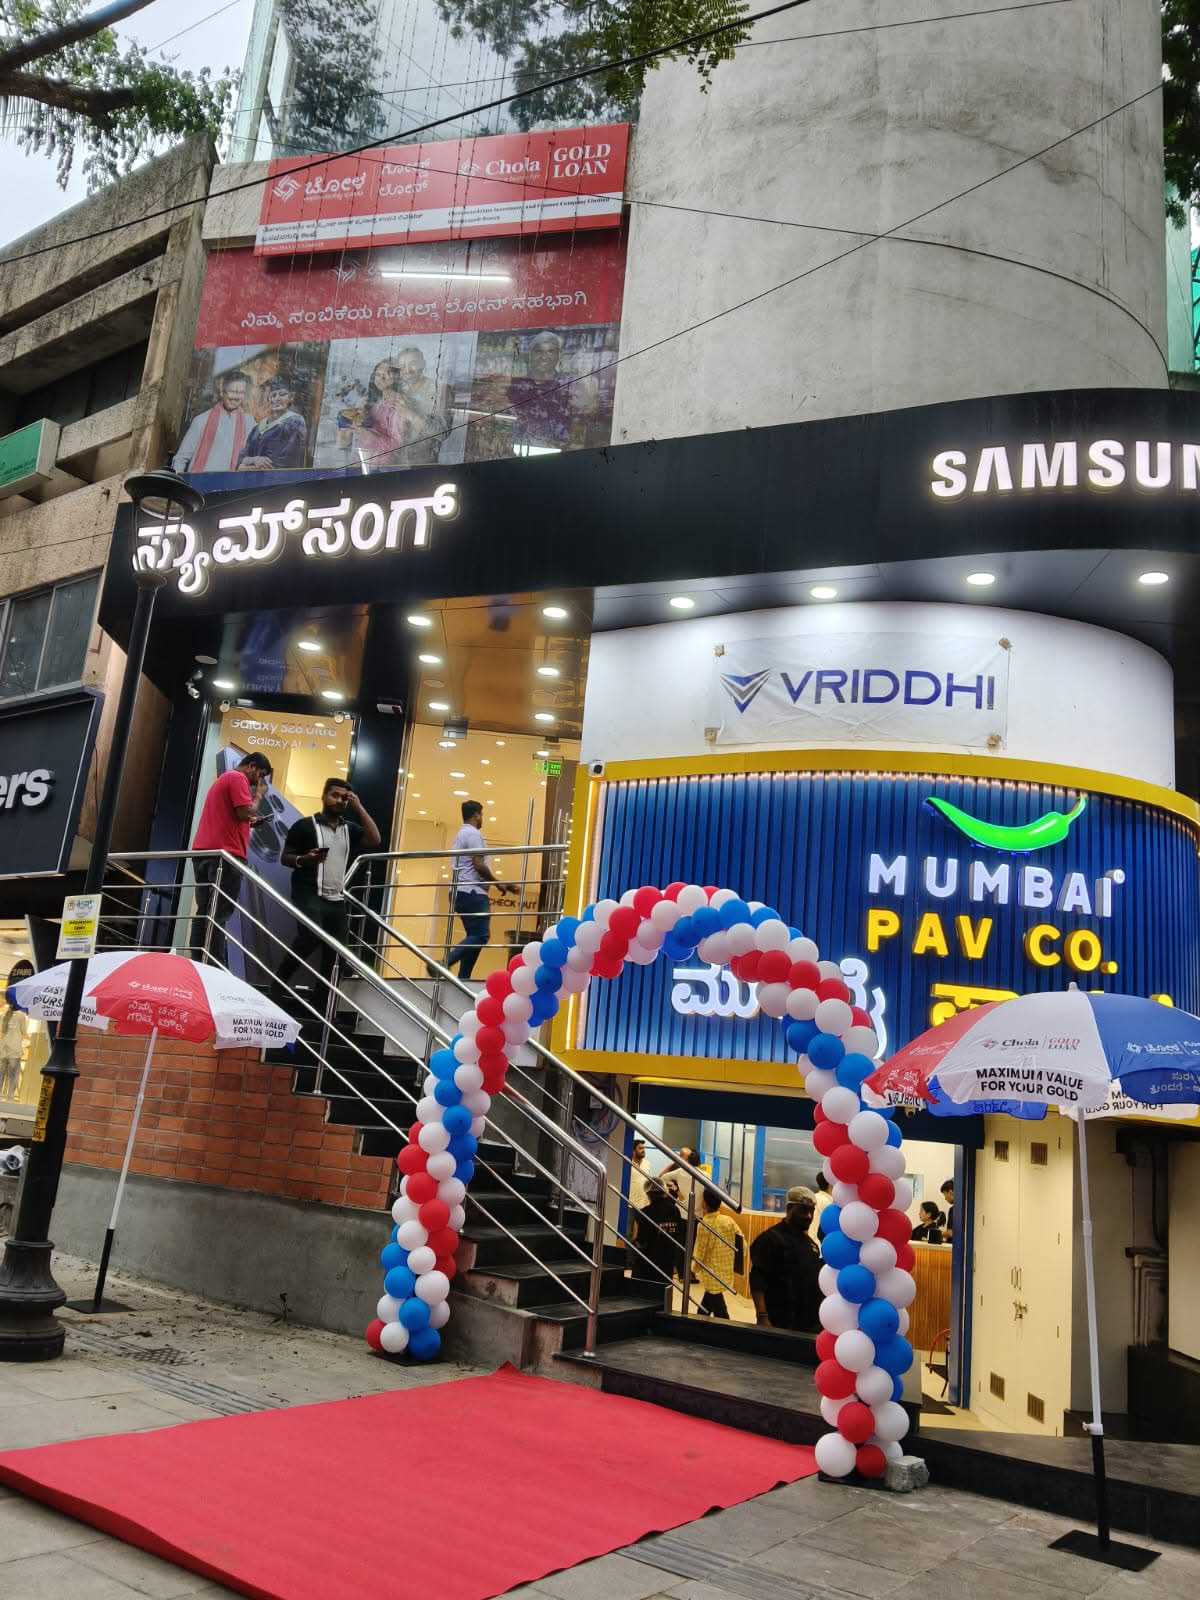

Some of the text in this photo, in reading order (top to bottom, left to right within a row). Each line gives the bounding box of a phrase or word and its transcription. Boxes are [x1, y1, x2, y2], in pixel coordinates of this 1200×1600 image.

[553, 143, 611, 162] GOLD
[485, 157, 540, 177] Chola
[553, 160, 609, 178] LOAN
[780, 669, 995, 711] VRIDDHI
[231, 719, 279, 733] Galaxy
[247, 736, 288, 749] Galaxy
[868, 853, 1112, 918] MUMBAI
[867, 908, 1118, 974] PAV CO.
[981, 1080, 1079, 1102] FOR YOUR GOLD
[1046, 1071, 1084, 1091] VALUE
